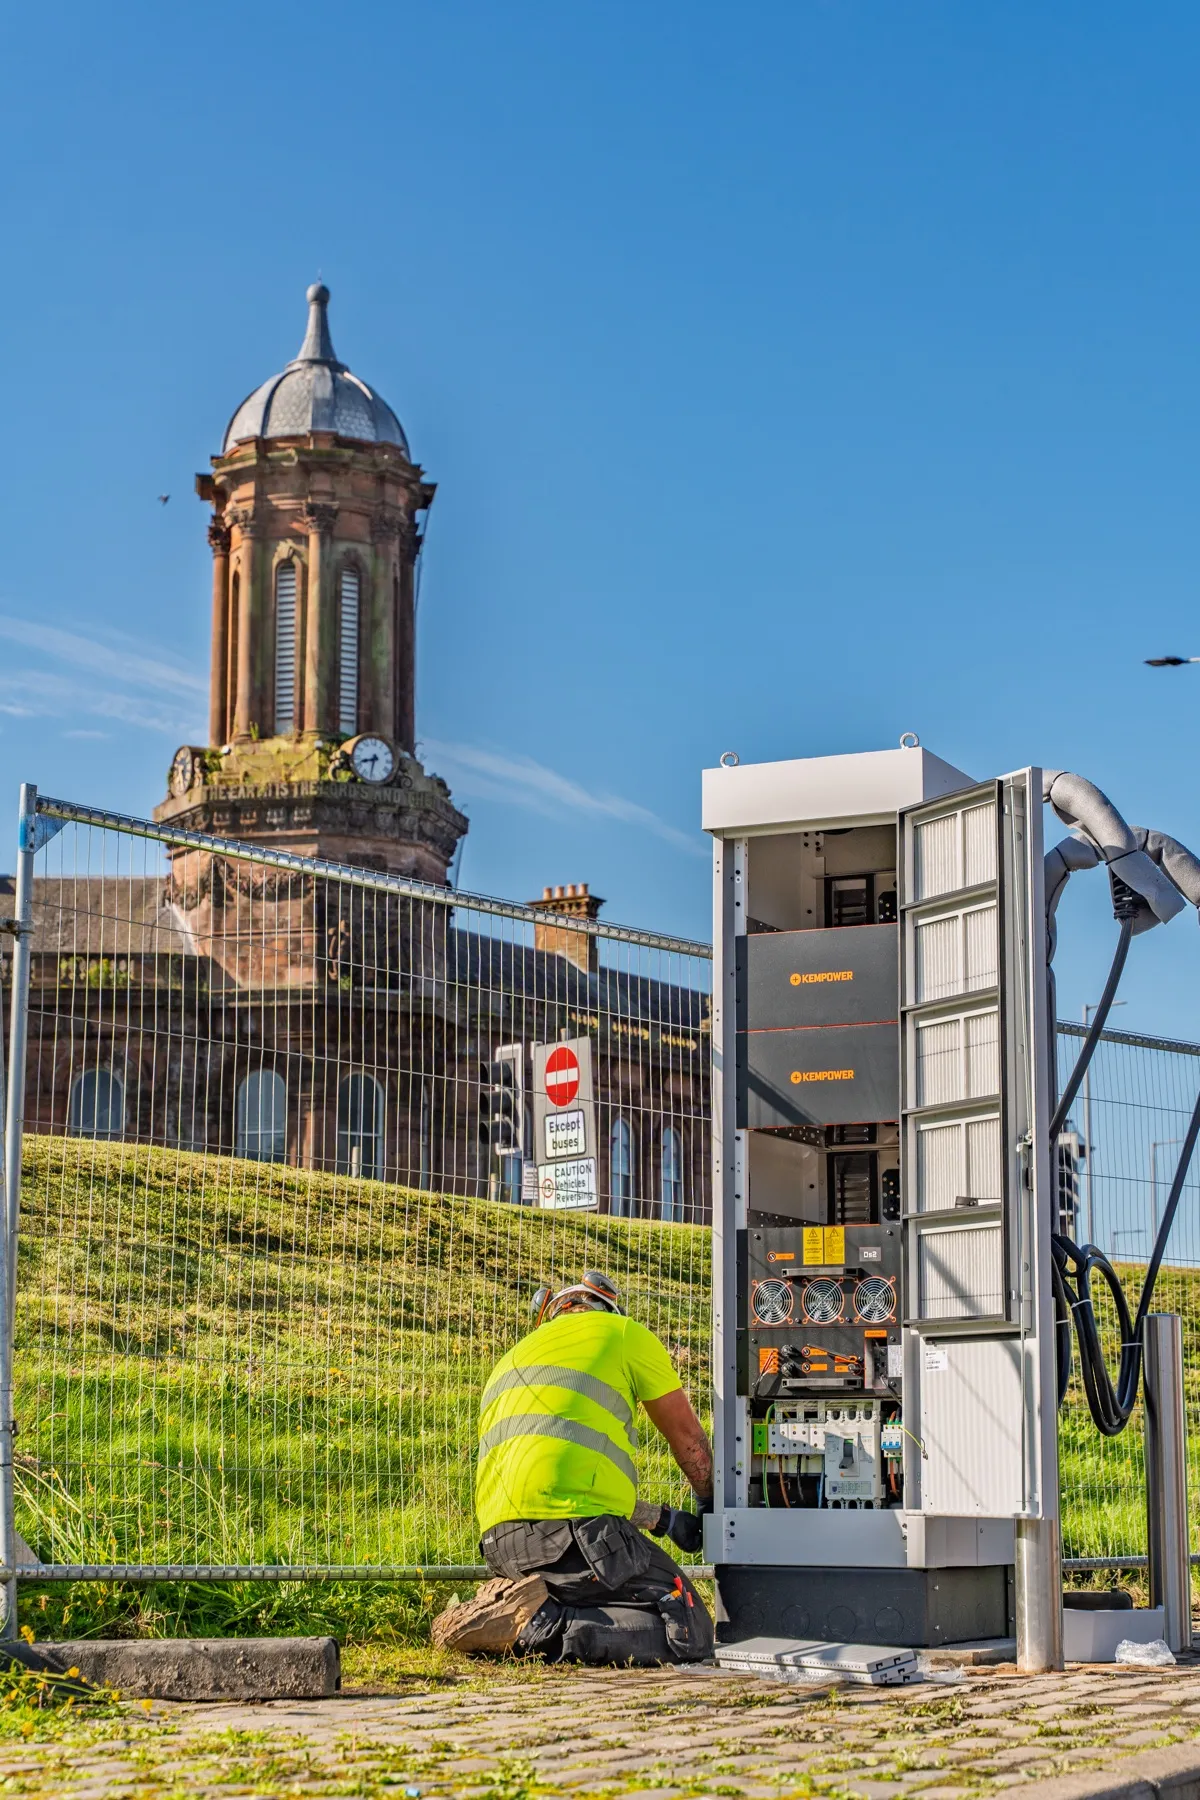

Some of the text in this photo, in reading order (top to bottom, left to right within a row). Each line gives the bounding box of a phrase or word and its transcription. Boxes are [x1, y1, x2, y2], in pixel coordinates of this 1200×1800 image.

[203, 784, 227, 800] THE
[275, 781, 289, 799] IS
[290, 780, 318, 798] THE
[802, 971, 853, 983] KEMPOWER
[802, 1069, 854, 1082] KEMPOWER
[549, 1118, 581, 1133] Except
[552, 1137, 579, 1150] buses
[555, 1164, 592, 1178] CAUTION
[555, 1179, 586, 1190] Vehicles
[556, 1191, 593, 1203] Reversing
